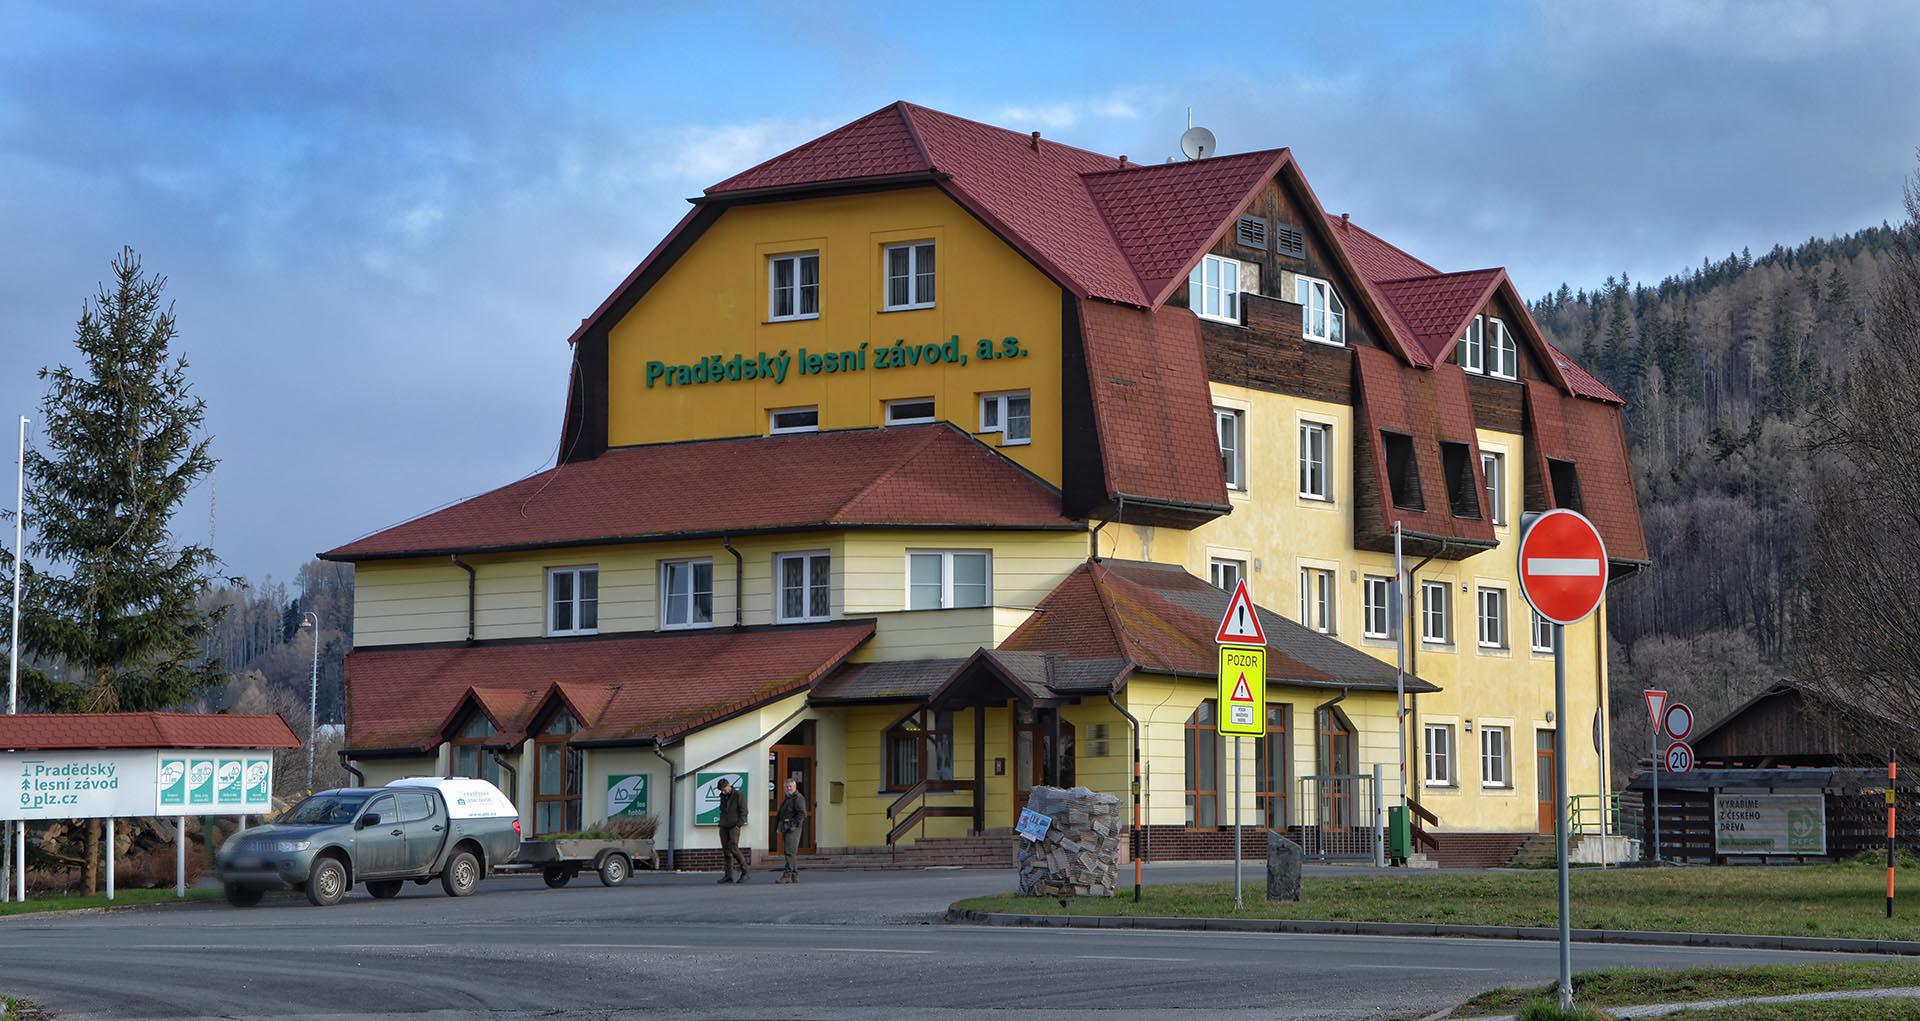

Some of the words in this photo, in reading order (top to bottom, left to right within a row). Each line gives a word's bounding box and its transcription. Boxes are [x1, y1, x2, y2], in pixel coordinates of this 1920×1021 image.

[646, 350, 791, 388] Pradědský
[798, 342, 868, 376] lesní
[873, 335, 968, 370] závod,
[976, 336, 1029, 361] a.s.
[1227, 654, 1258, 667] POZOR
[1671, 751, 1688, 769] 20
[35, 762, 116, 778] Pradědský
[35, 777, 71, 791] lesní
[74, 777, 118, 790] závod
[34, 792, 78, 808] plz.cz
